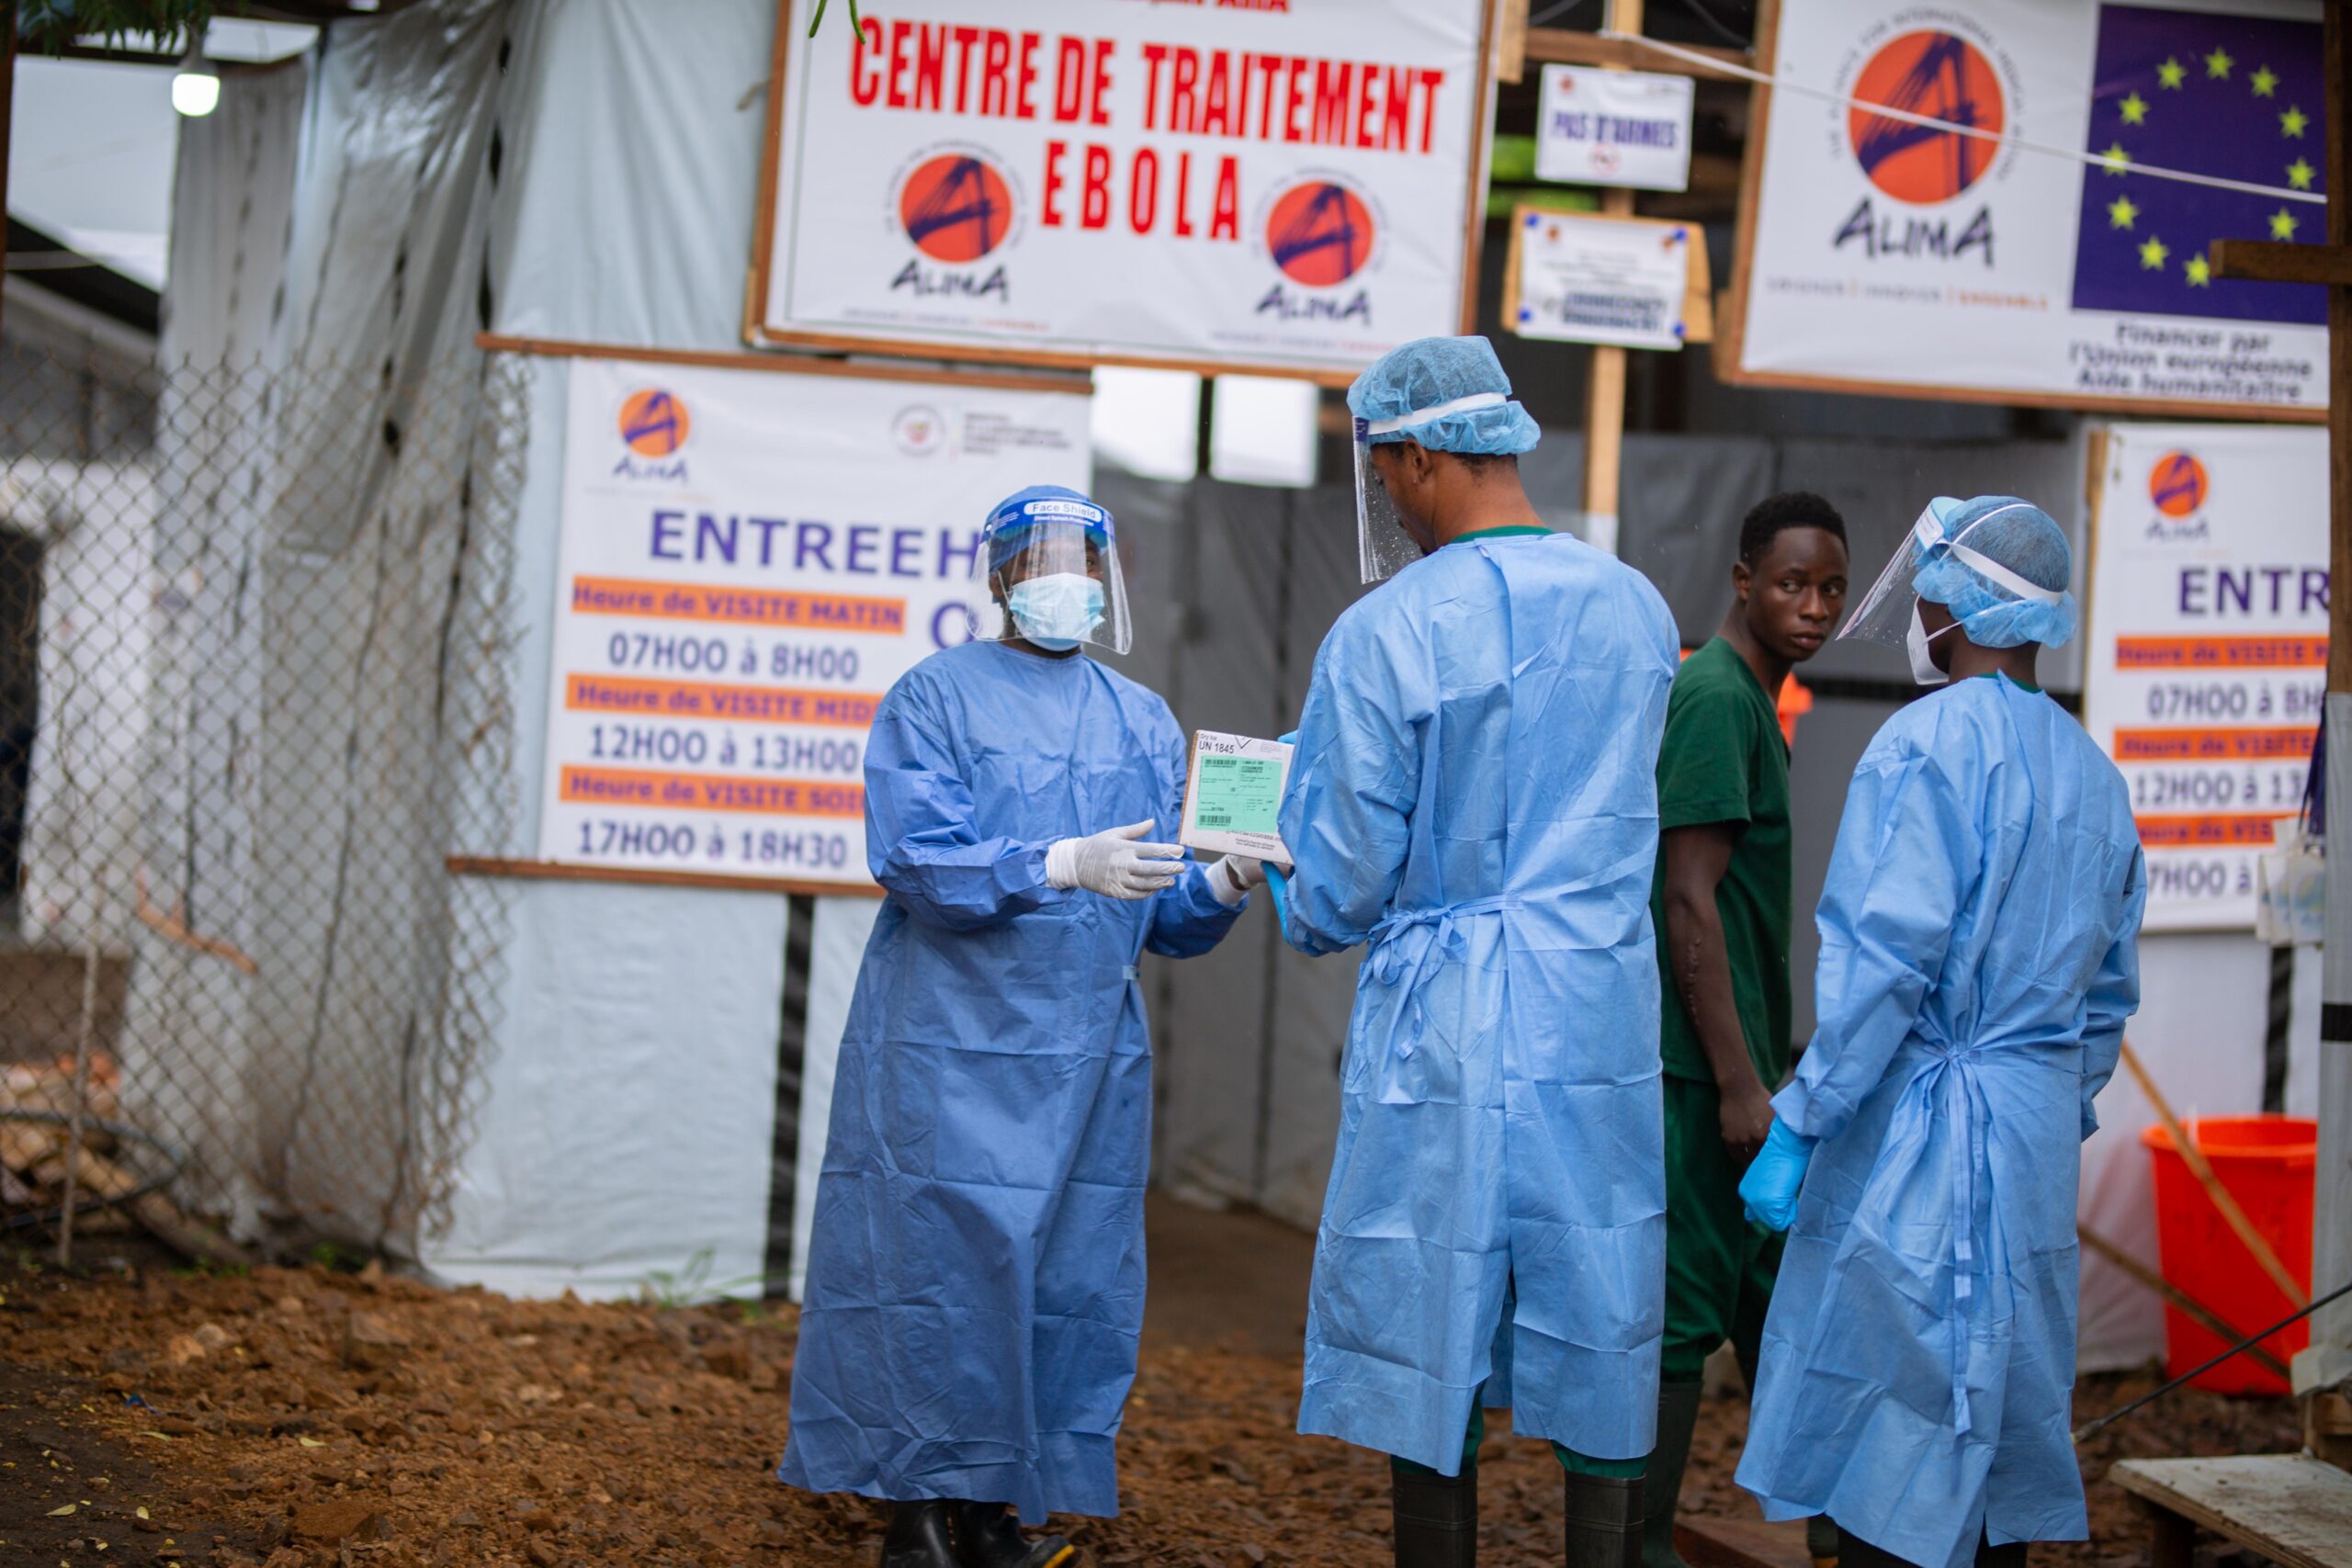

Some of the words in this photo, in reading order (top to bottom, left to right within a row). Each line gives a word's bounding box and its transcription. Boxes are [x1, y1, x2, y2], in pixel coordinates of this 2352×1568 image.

[851, 17, 1038, 120] CENTRE
[1054, 36, 1114, 129] DE
[1143, 44, 1444, 154] TRAITEMENT
[1042, 141, 1241, 242] EBOLA
[1833, 197, 1995, 269] ALIMA
[888, 258, 1010, 304] ALIMA
[1255, 283, 1371, 327] ALIMA
[1032, 503, 1059, 513] Face
[1063, 503, 1097, 519] Shield
[648, 510, 979, 581] ENTREEH
[573, 583, 653, 611] Heure
[662, 589, 695, 614] de
[705, 592, 800, 621] VISITE
[808, 602, 902, 628] MATIN
[2178, 566, 2330, 615] ENTR
[739, 637, 759, 676] à
[577, 682, 661, 712] Heure
[668, 688, 701, 714] de
[711, 693, 805, 719] VISITE
[816, 699, 879, 724] MID
[719, 728, 738, 768] à
[1198, 740, 1212, 750] UN
[1215, 742, 1235, 754] 1845
[571, 773, 653, 799] Heure
[662, 777, 695, 802] de
[705, 783, 798, 811] VISITE
[808, 787, 865, 814] SOI
[706, 824, 725, 860] à
[740, 830, 848, 871] 18H30
